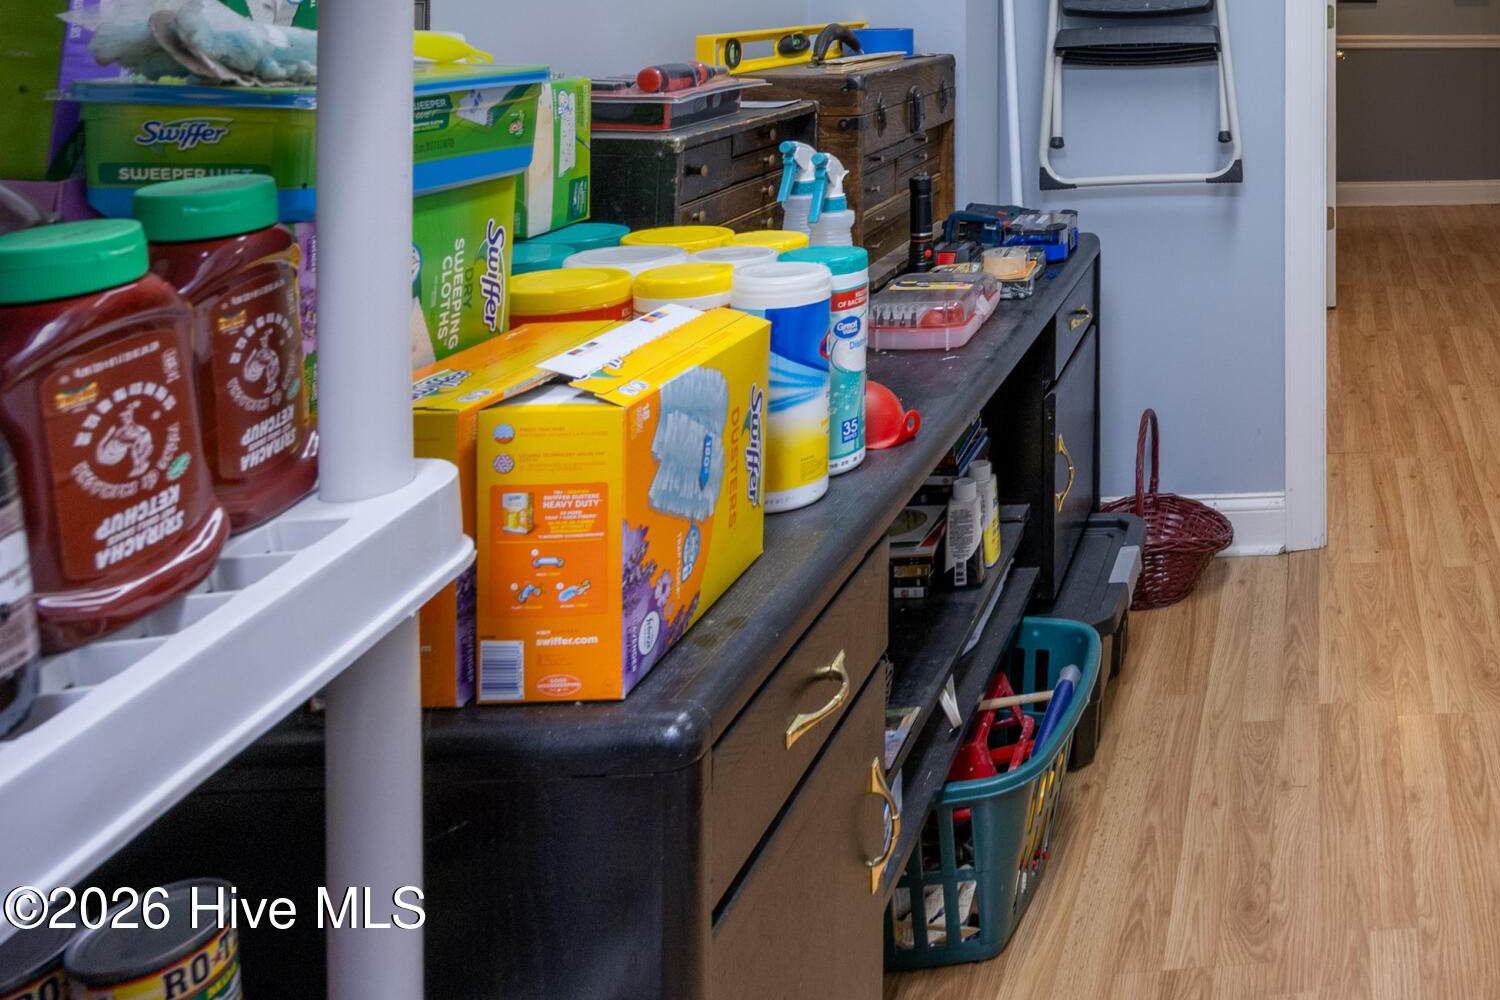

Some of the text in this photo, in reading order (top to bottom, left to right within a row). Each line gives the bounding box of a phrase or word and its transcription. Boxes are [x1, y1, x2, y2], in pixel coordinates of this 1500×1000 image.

[135, 119, 229, 151] Swiffer
[118, 167, 206, 180] SWEEPER
[447, 238, 465, 350] SWEEPING
[463, 267, 475, 309] DRY
[480, 218, 506, 332] Swiffer
[437, 255, 453, 340] CLOTHS
[836, 320, 858, 332] Great
[240, 404, 294, 446] KETCHUP
[745, 382, 764, 507] Swiffer
[843, 419, 858, 436] 35
[240, 427, 296, 472] SRIRACHA
[728, 406, 741, 529] DUSTERS
[94, 483, 180, 541] KETCHUP
[542, 499, 600, 509] HEAVY DUTY
[94, 510, 185, 570] SRIRACHA
[536, 635, 599, 647] swiffer.com
